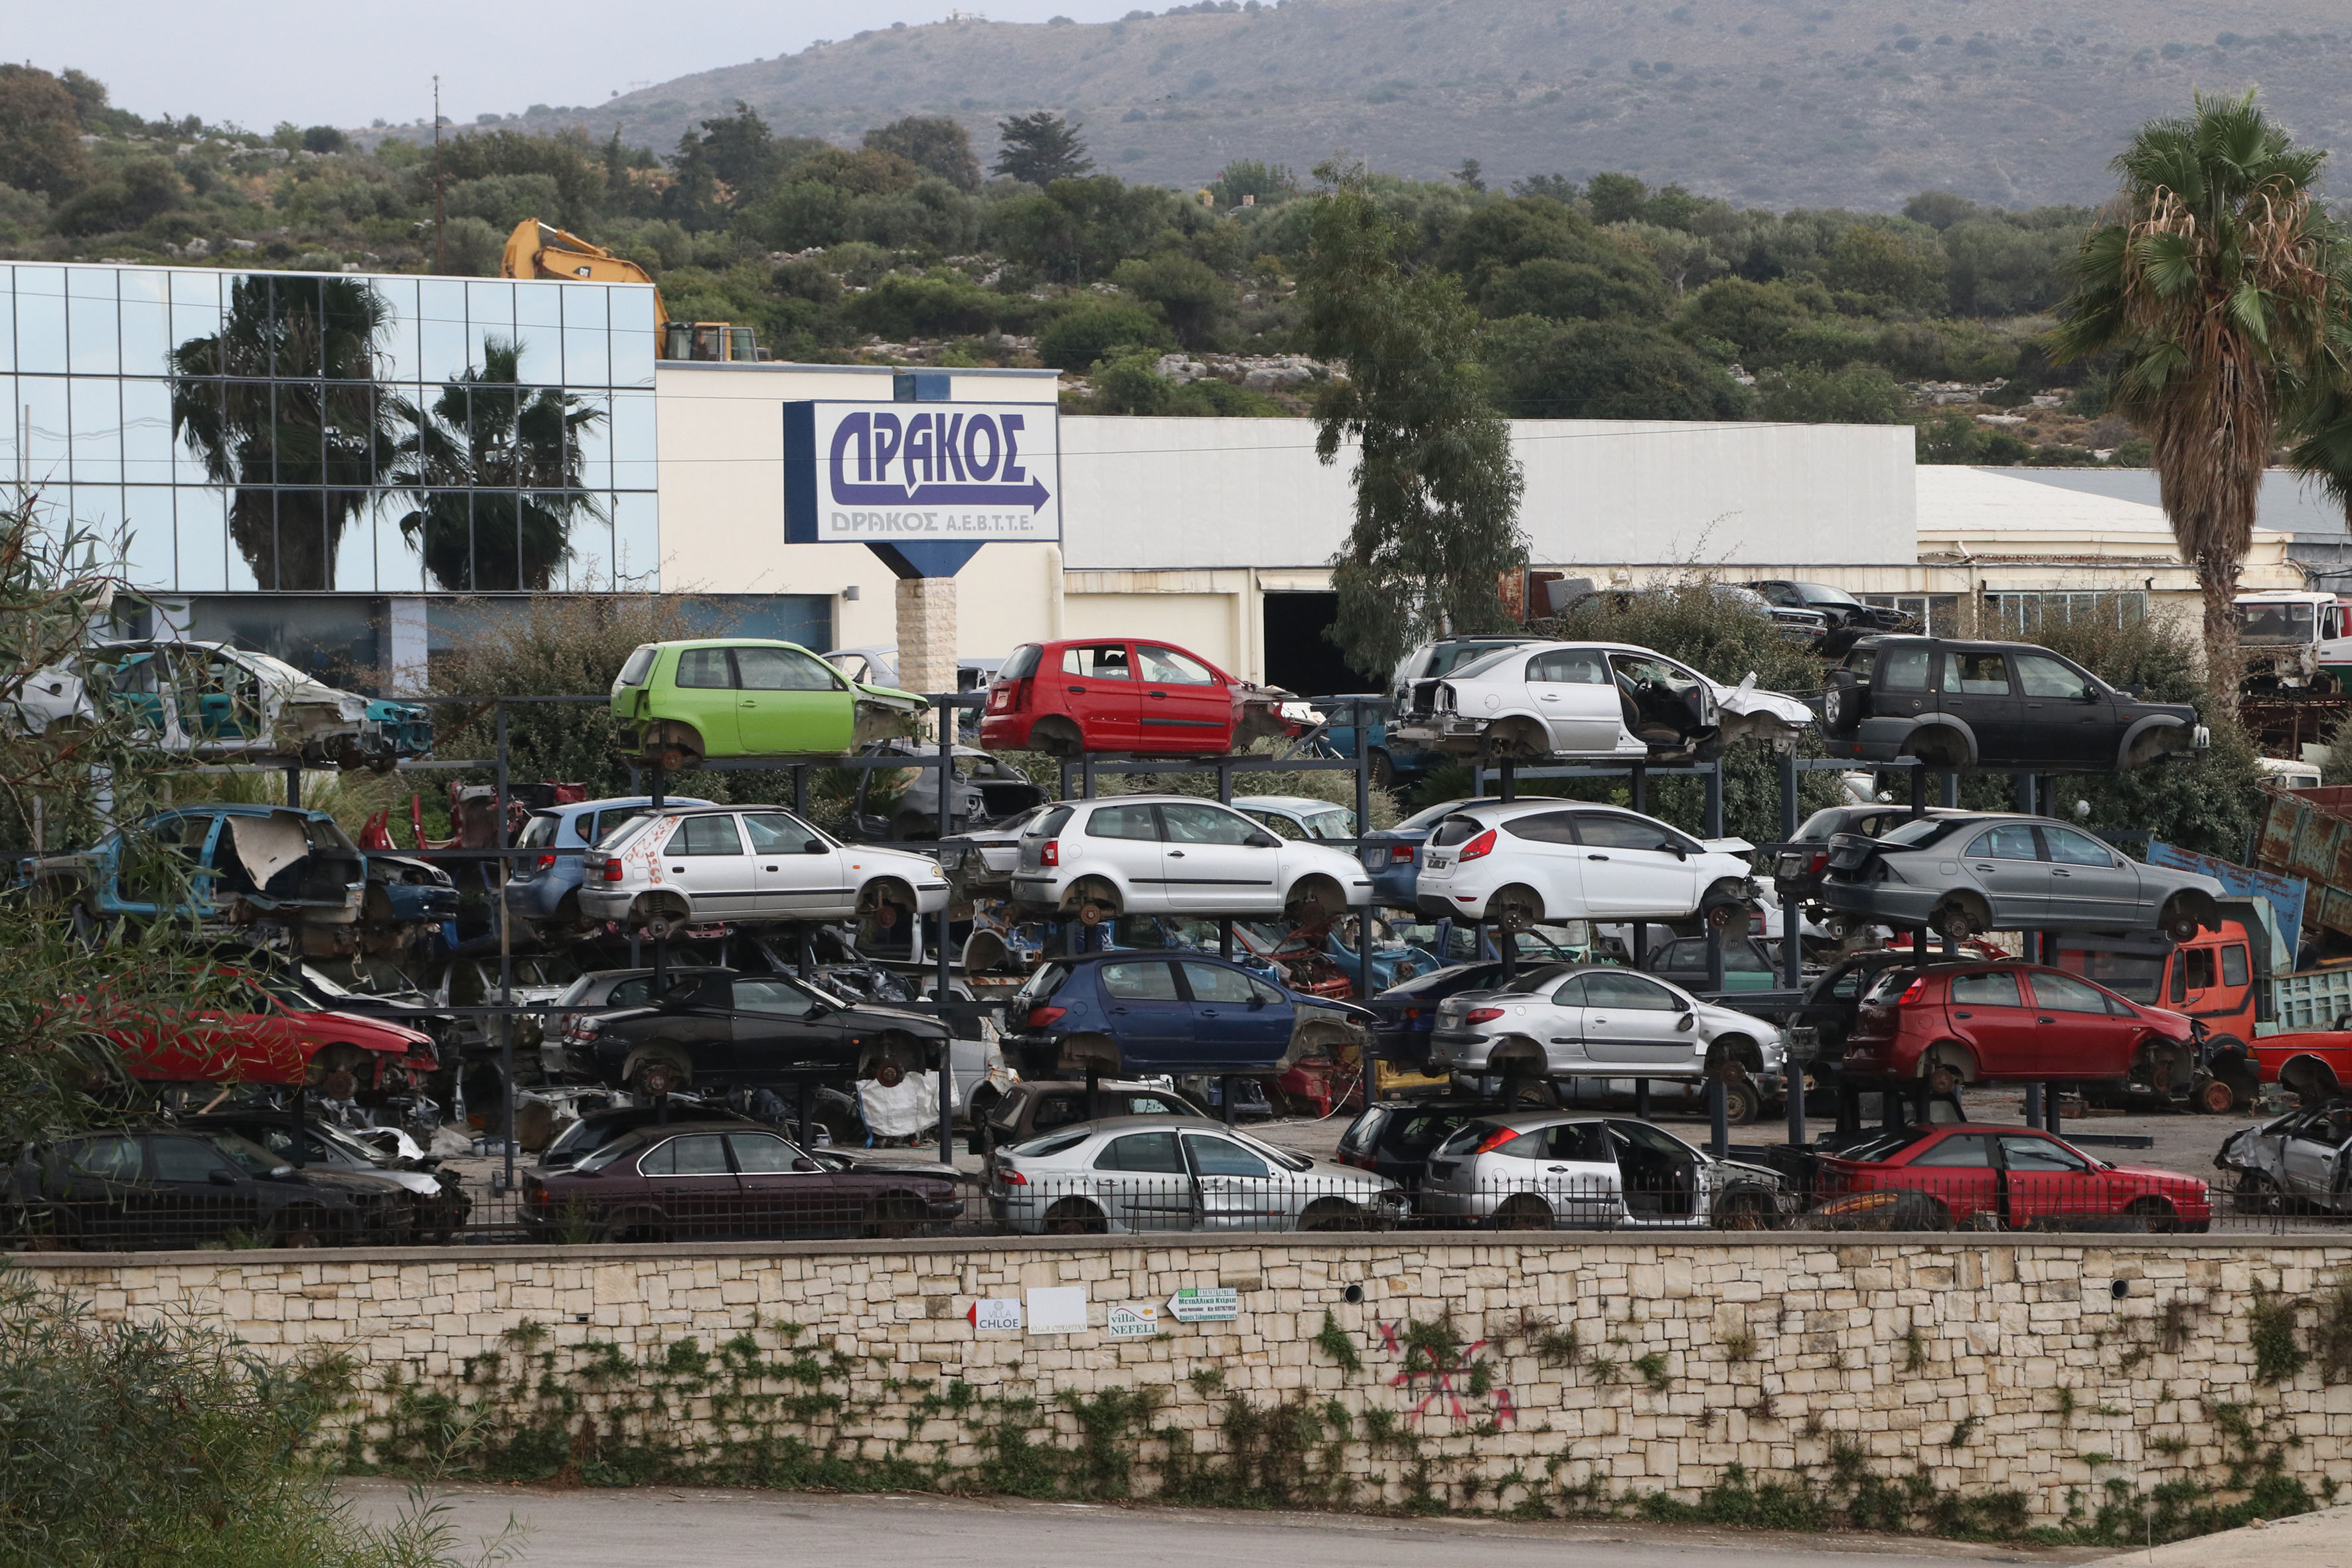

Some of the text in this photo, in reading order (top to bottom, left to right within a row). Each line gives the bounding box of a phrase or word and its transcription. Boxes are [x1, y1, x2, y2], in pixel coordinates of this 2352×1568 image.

[979, 1318, 1018, 1328] CHLOE
[1111, 1314, 1135, 1323] villa
[1111, 1324, 1156, 1336] NEFELI
